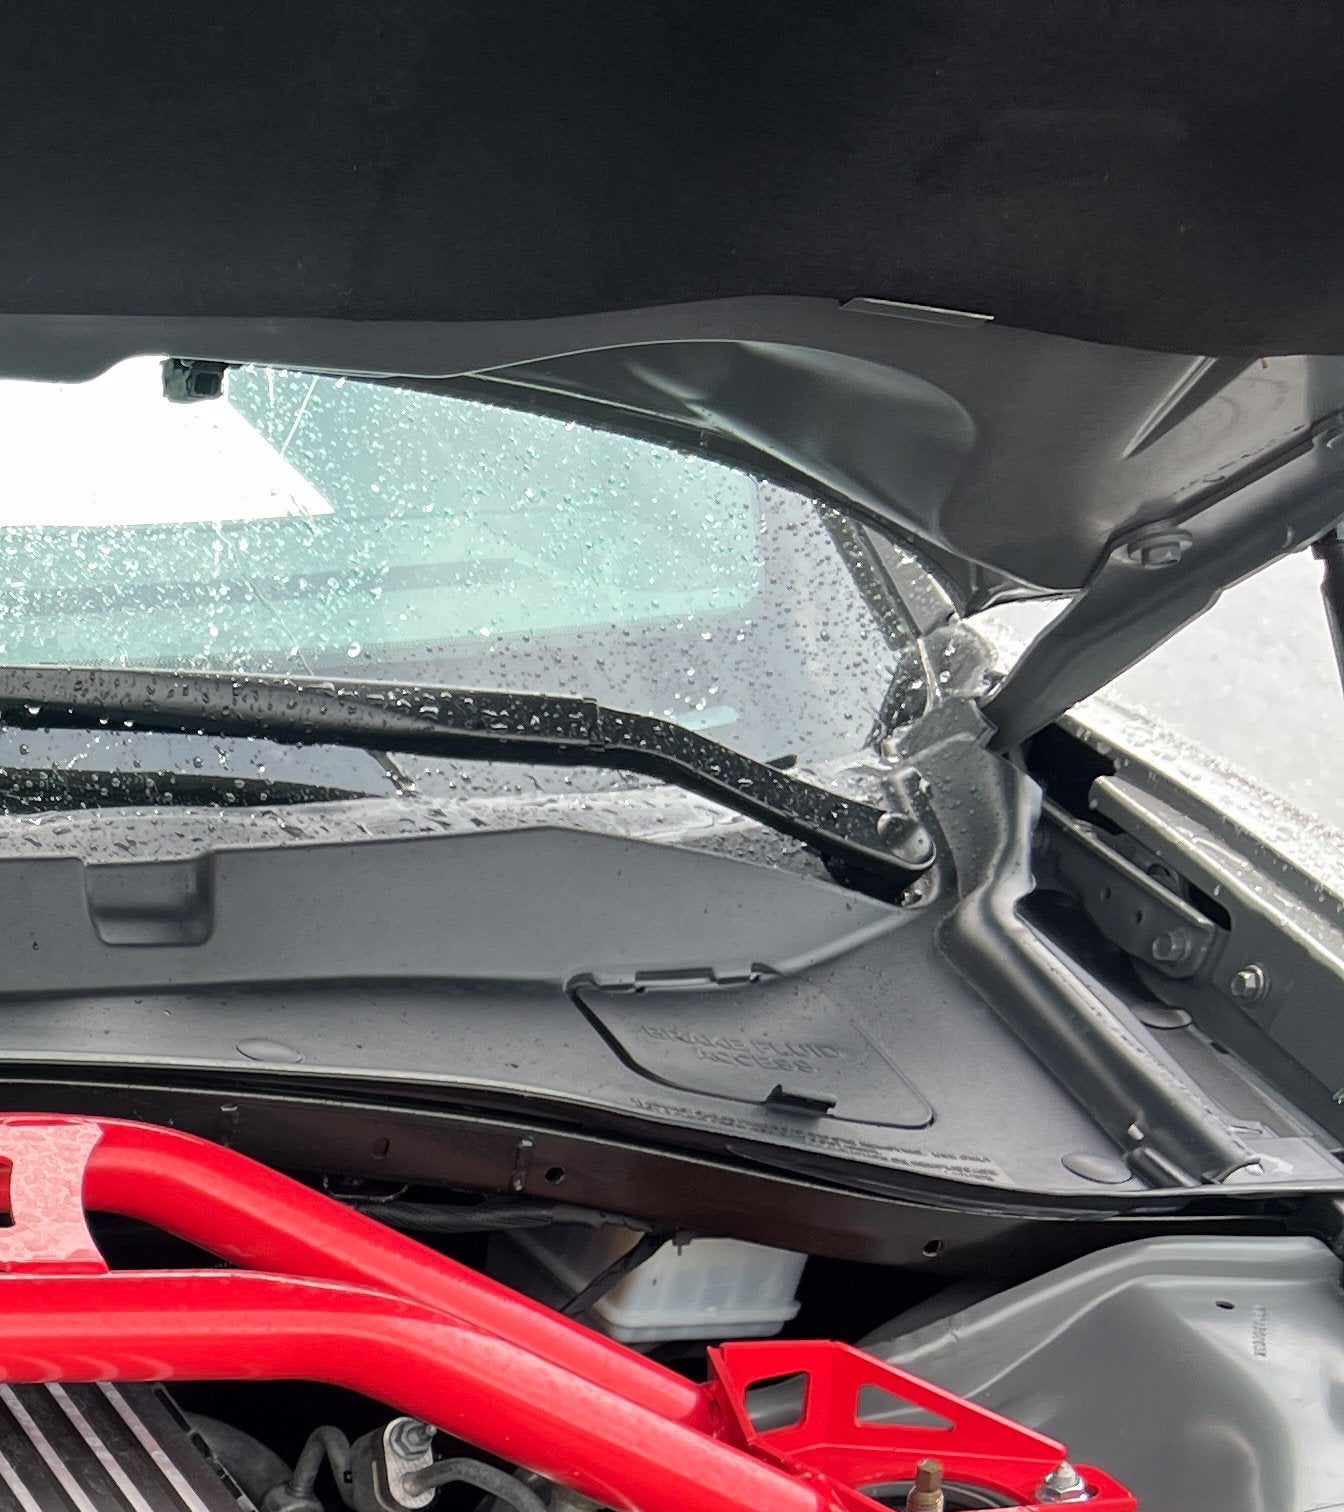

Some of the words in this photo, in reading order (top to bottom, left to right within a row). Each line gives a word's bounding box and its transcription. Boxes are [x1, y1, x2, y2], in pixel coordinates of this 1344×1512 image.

[641, 1026, 749, 1051] BRAKE
[750, 1039, 840, 1059] FLUID
[694, 1048, 813, 1074] ACCESS
